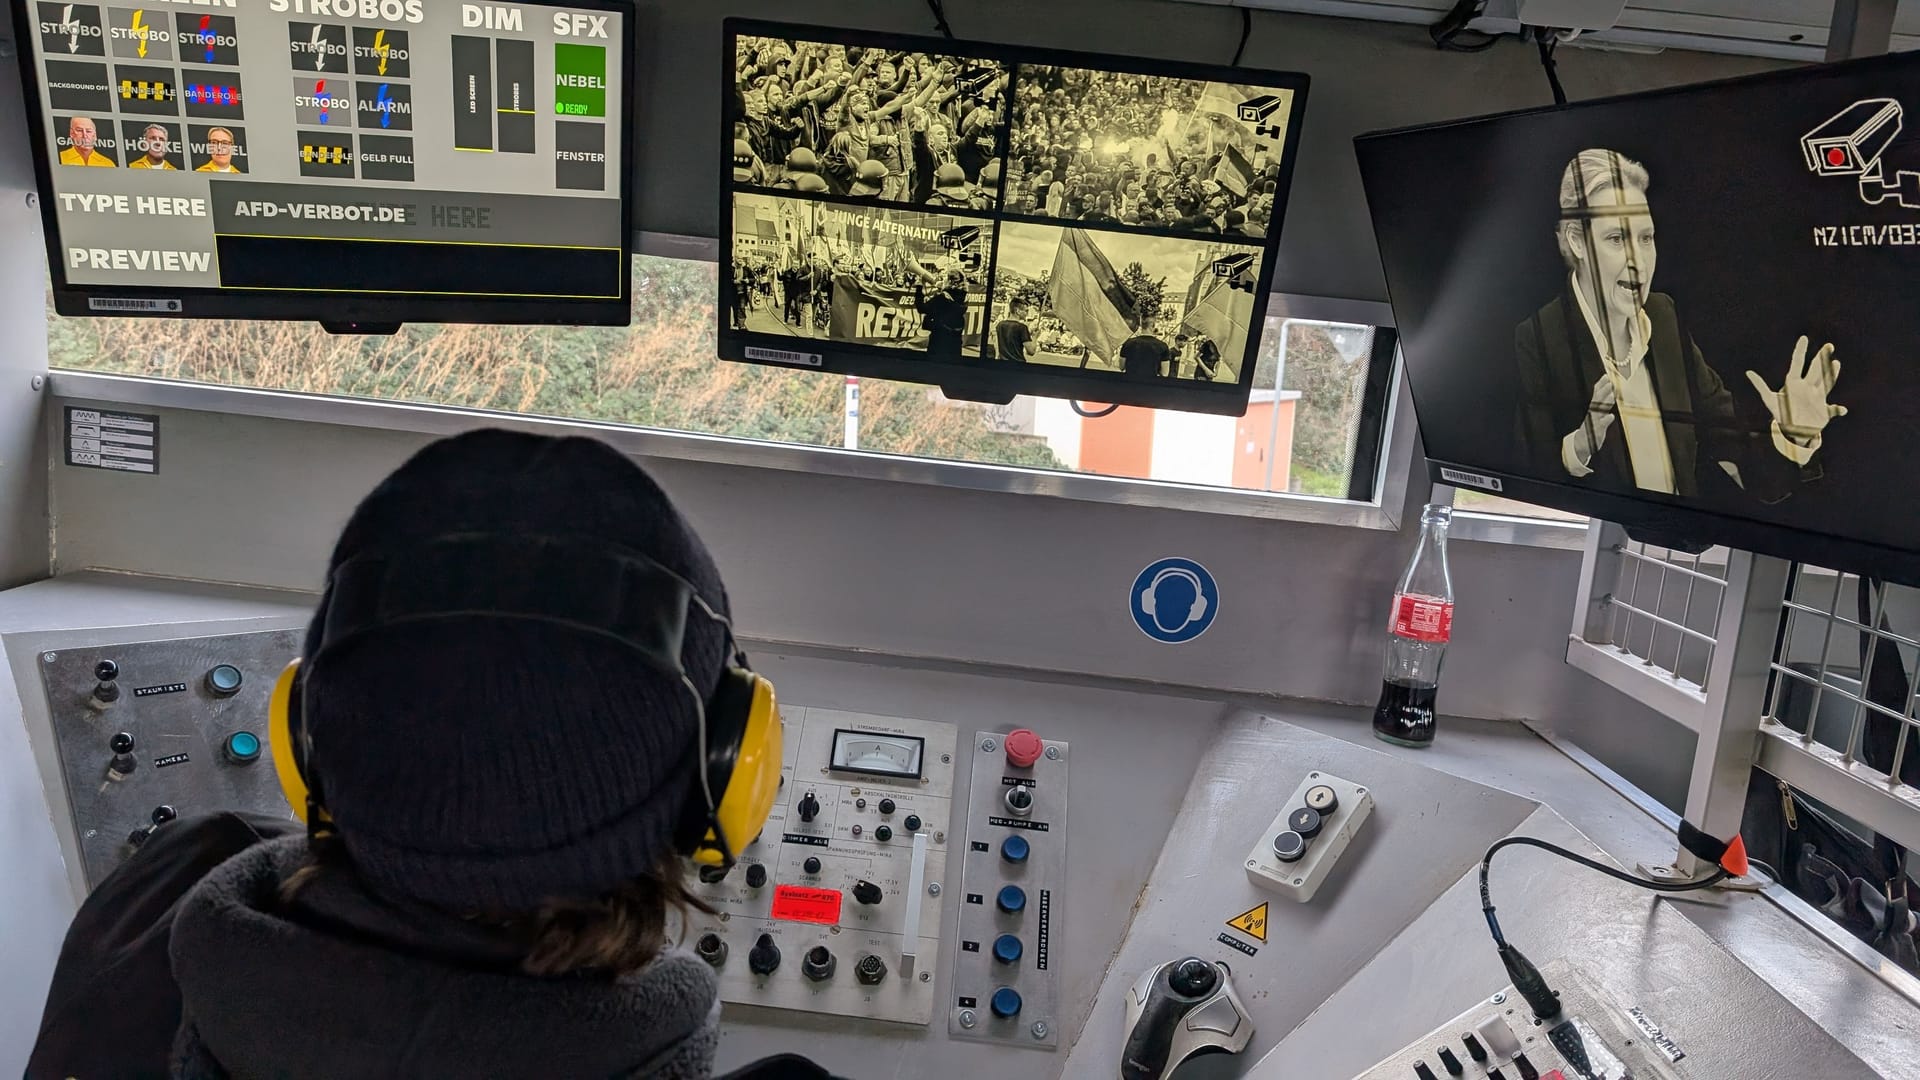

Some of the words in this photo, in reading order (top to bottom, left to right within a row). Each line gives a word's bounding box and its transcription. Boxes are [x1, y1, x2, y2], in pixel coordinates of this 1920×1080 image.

[462, 4, 523, 31] DIM
[41, 22, 101, 37] STROBO
[553, 12, 608, 38] SFX
[111, 27, 169, 42] STROBO
[179, 33, 236, 47] STROBO
[291, 41, 346, 55] STROBO
[355, 47, 408, 60] STROBO
[49, 82, 94, 91] BACKGROUND
[556, 74, 605, 89] NEBEL
[118, 85, 176, 96] BANDEROLE
[185, 90, 242, 100] BANDEROLE
[295, 96, 349, 109] STROBO
[358, 100, 410, 114] ALARM
[565, 105, 588, 114] READY
[57, 137, 115, 148] GAULAND
[125, 135, 182, 153] HÖCKE
[361, 153, 387, 163] GELB
[389, 155, 413, 164] FULL
[557, 151, 604, 162] FENSTER
[59, 193, 130, 214] TYPE
[136, 196, 206, 217] HERE
[235, 201, 406, 223] AFD-VERBOT.DE
[431, 205, 491, 229] HERE
[832, 209, 870, 228] JUNGE
[69, 247, 211, 272] PREVIEW
[155, 755, 188, 765] KAMERA
[1220, 934, 1254, 954] COMPUTER
